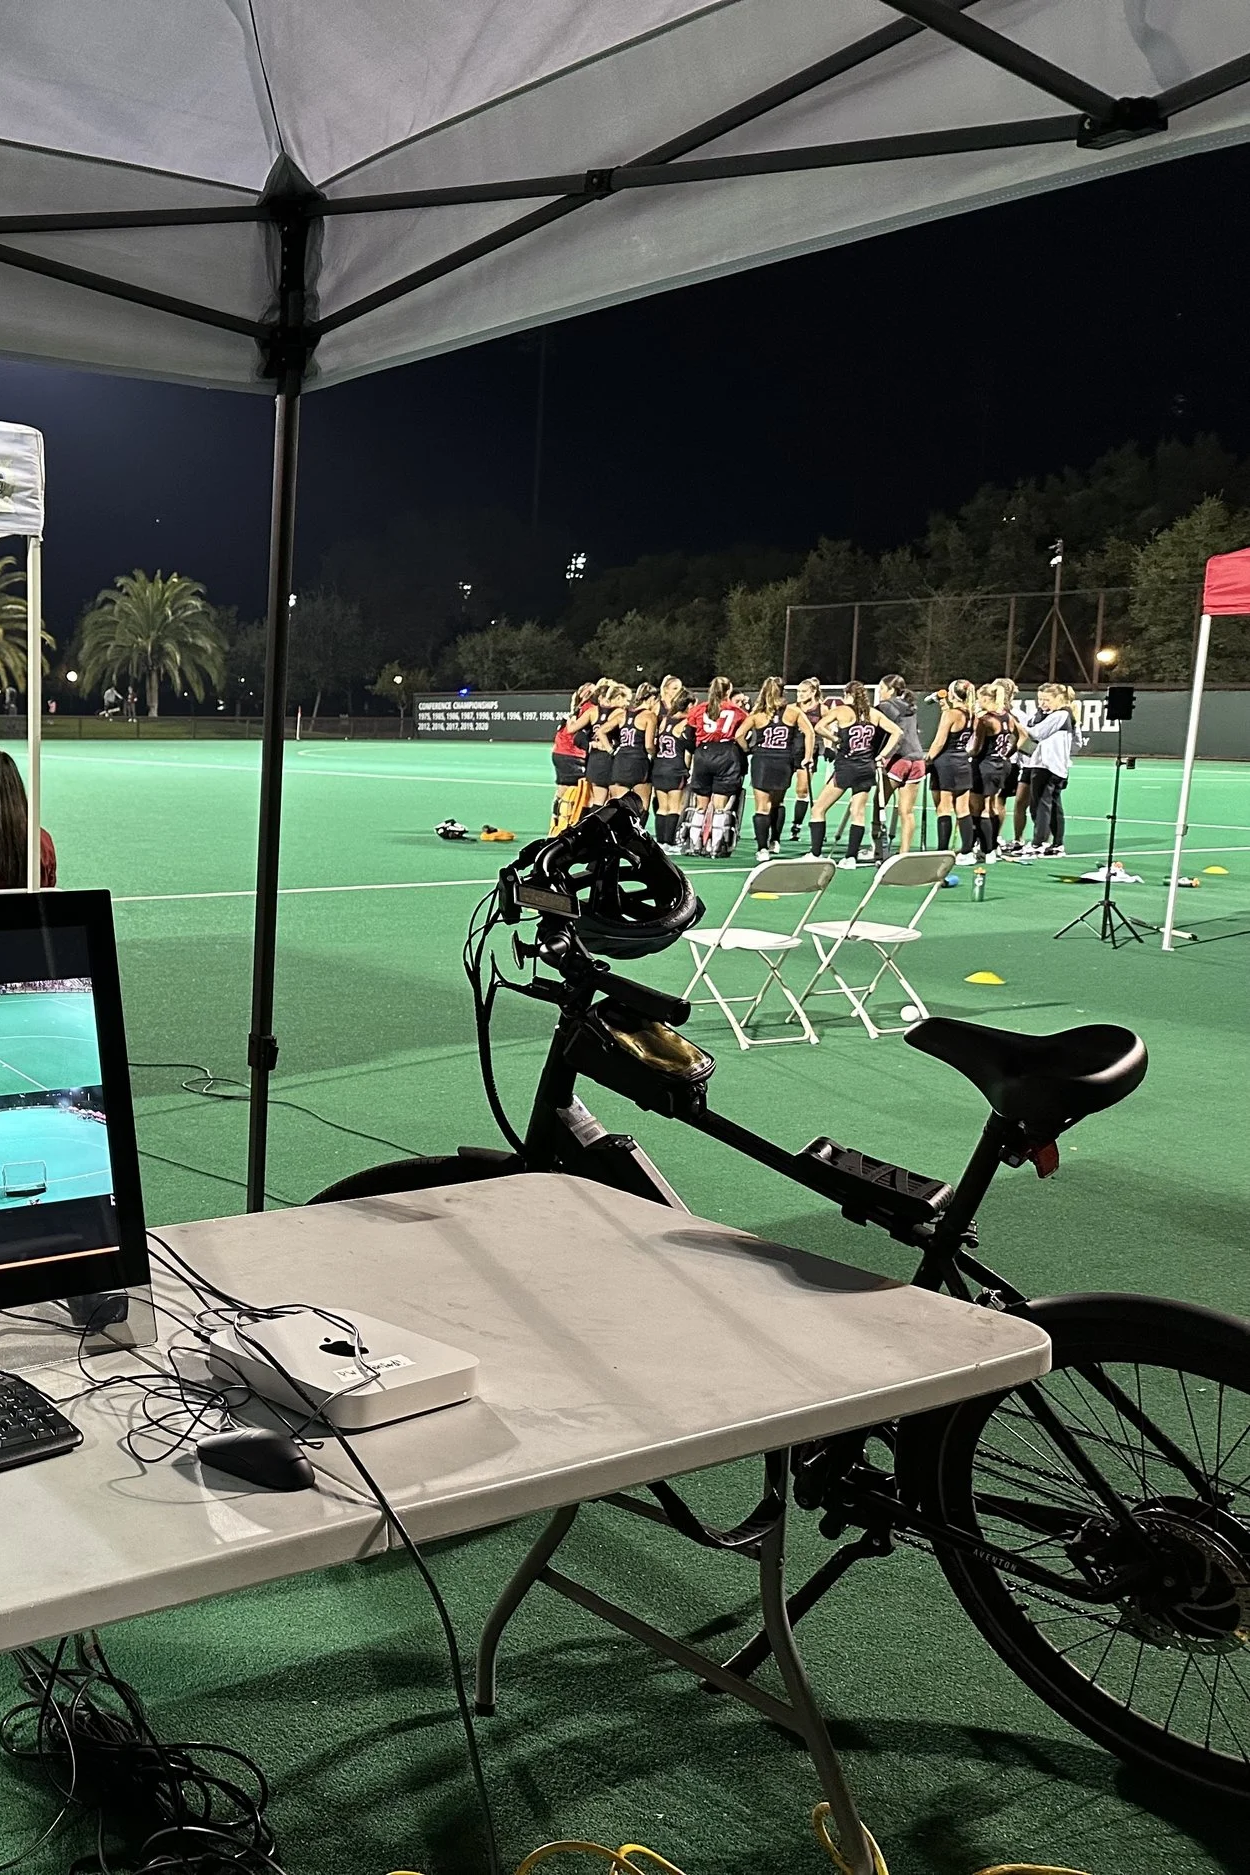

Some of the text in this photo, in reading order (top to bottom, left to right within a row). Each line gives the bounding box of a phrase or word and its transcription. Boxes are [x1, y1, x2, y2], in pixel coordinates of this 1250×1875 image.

[418, 701, 499, 710] CONFERENCE CHAMPIONSHIPS
[703, 710, 735, 734] 57
[620, 728, 636, 748] 21
[657, 736, 677, 759] 13
[762, 726, 789, 749] 12
[849, 725, 876, 751] 22
[973, 1548, 1018, 1572] AVENTON
